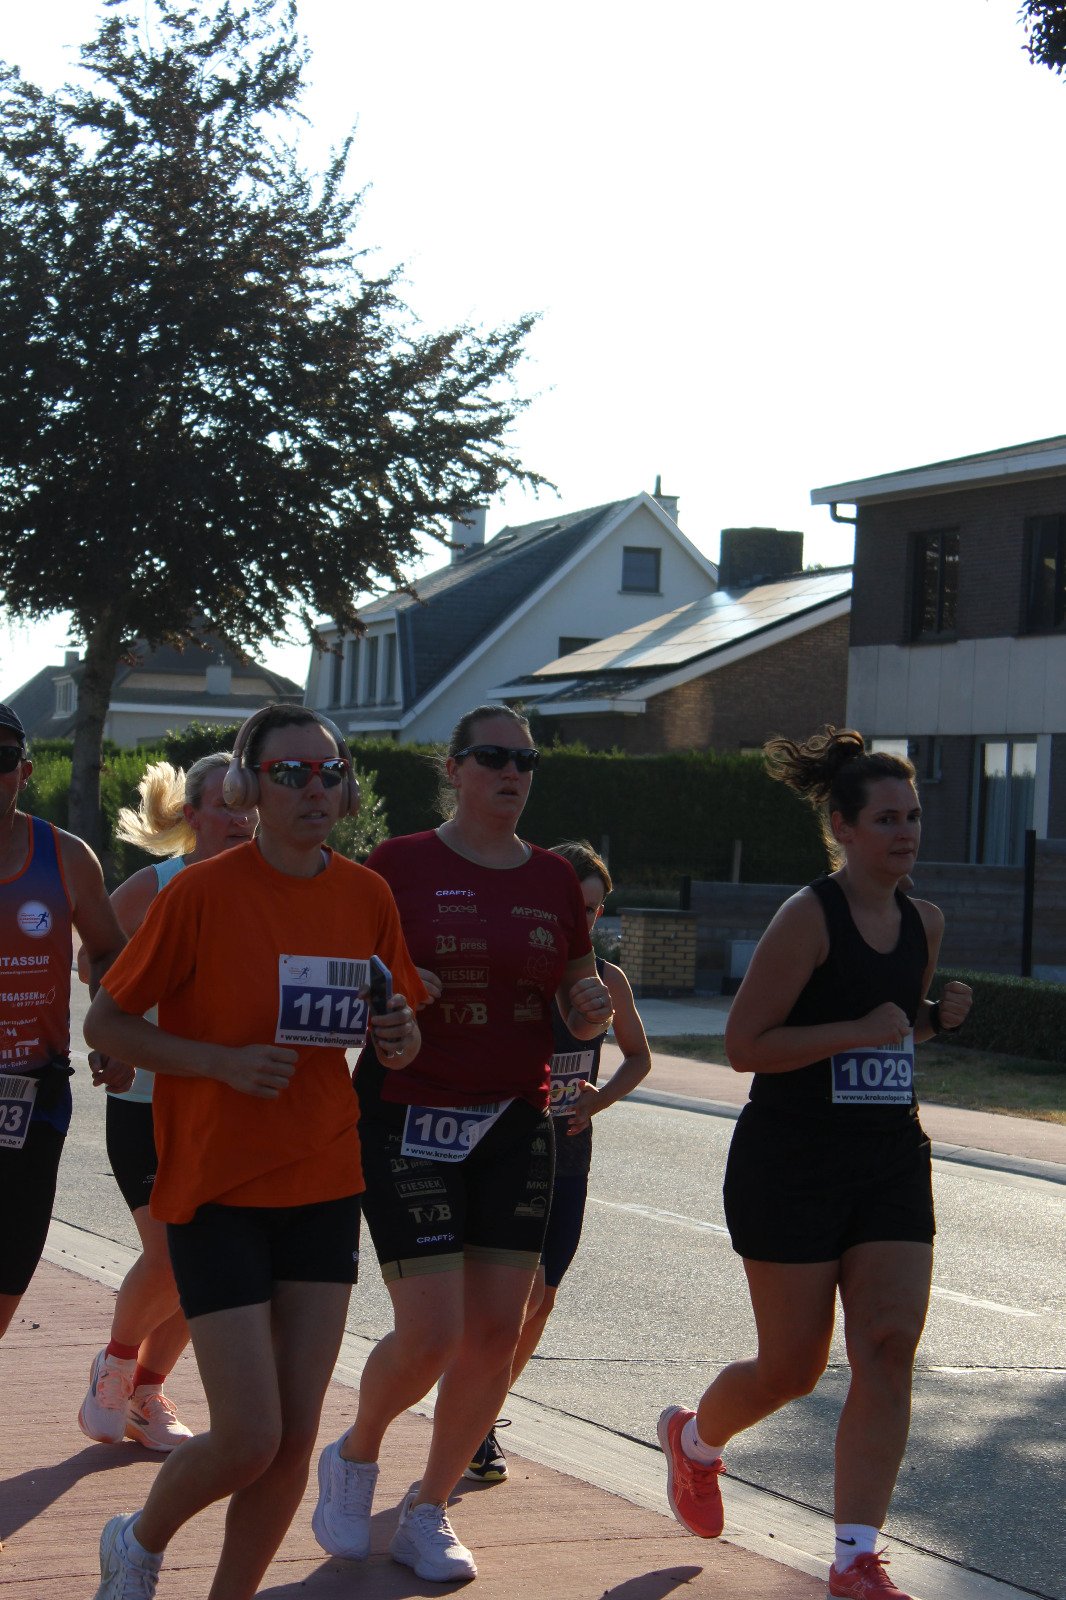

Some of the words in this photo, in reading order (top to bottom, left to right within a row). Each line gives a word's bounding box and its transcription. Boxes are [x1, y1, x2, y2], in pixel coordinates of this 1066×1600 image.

[460, 942, 487, 951] press
[293, 992, 364, 1029] 1112
[440, 1003, 487, 1024] TvB
[841, 1058, 911, 1087] 1029
[408, 1204, 452, 1223] TvB
[416, 1234, 448, 1244] CRAFT
